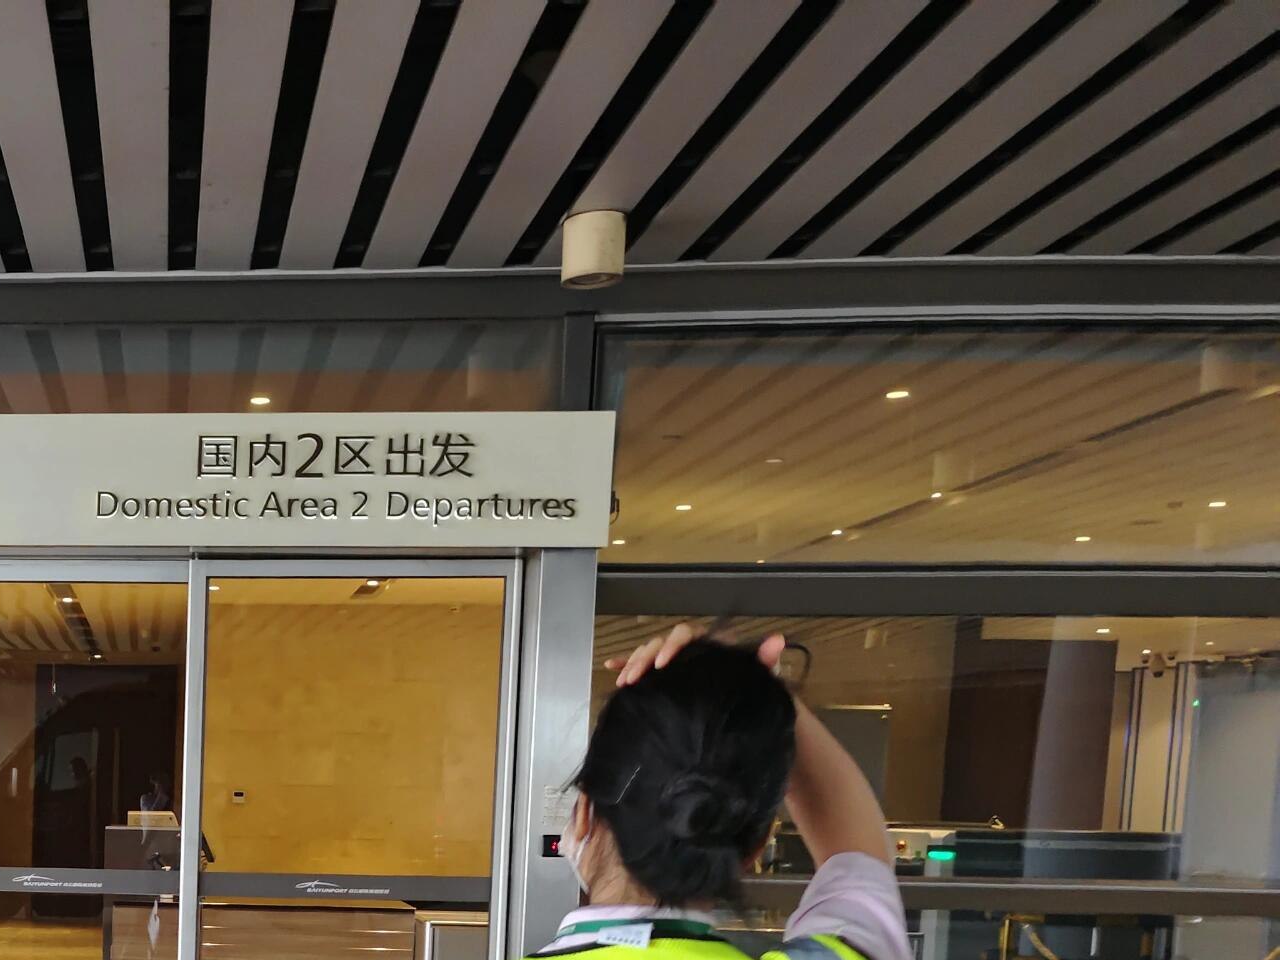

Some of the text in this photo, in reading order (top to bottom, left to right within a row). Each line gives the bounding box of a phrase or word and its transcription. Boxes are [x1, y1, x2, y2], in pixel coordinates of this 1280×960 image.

[196, 433, 476, 480] 国内2区出发
[95, 490, 577, 527] Domestic Area 2 Departures
